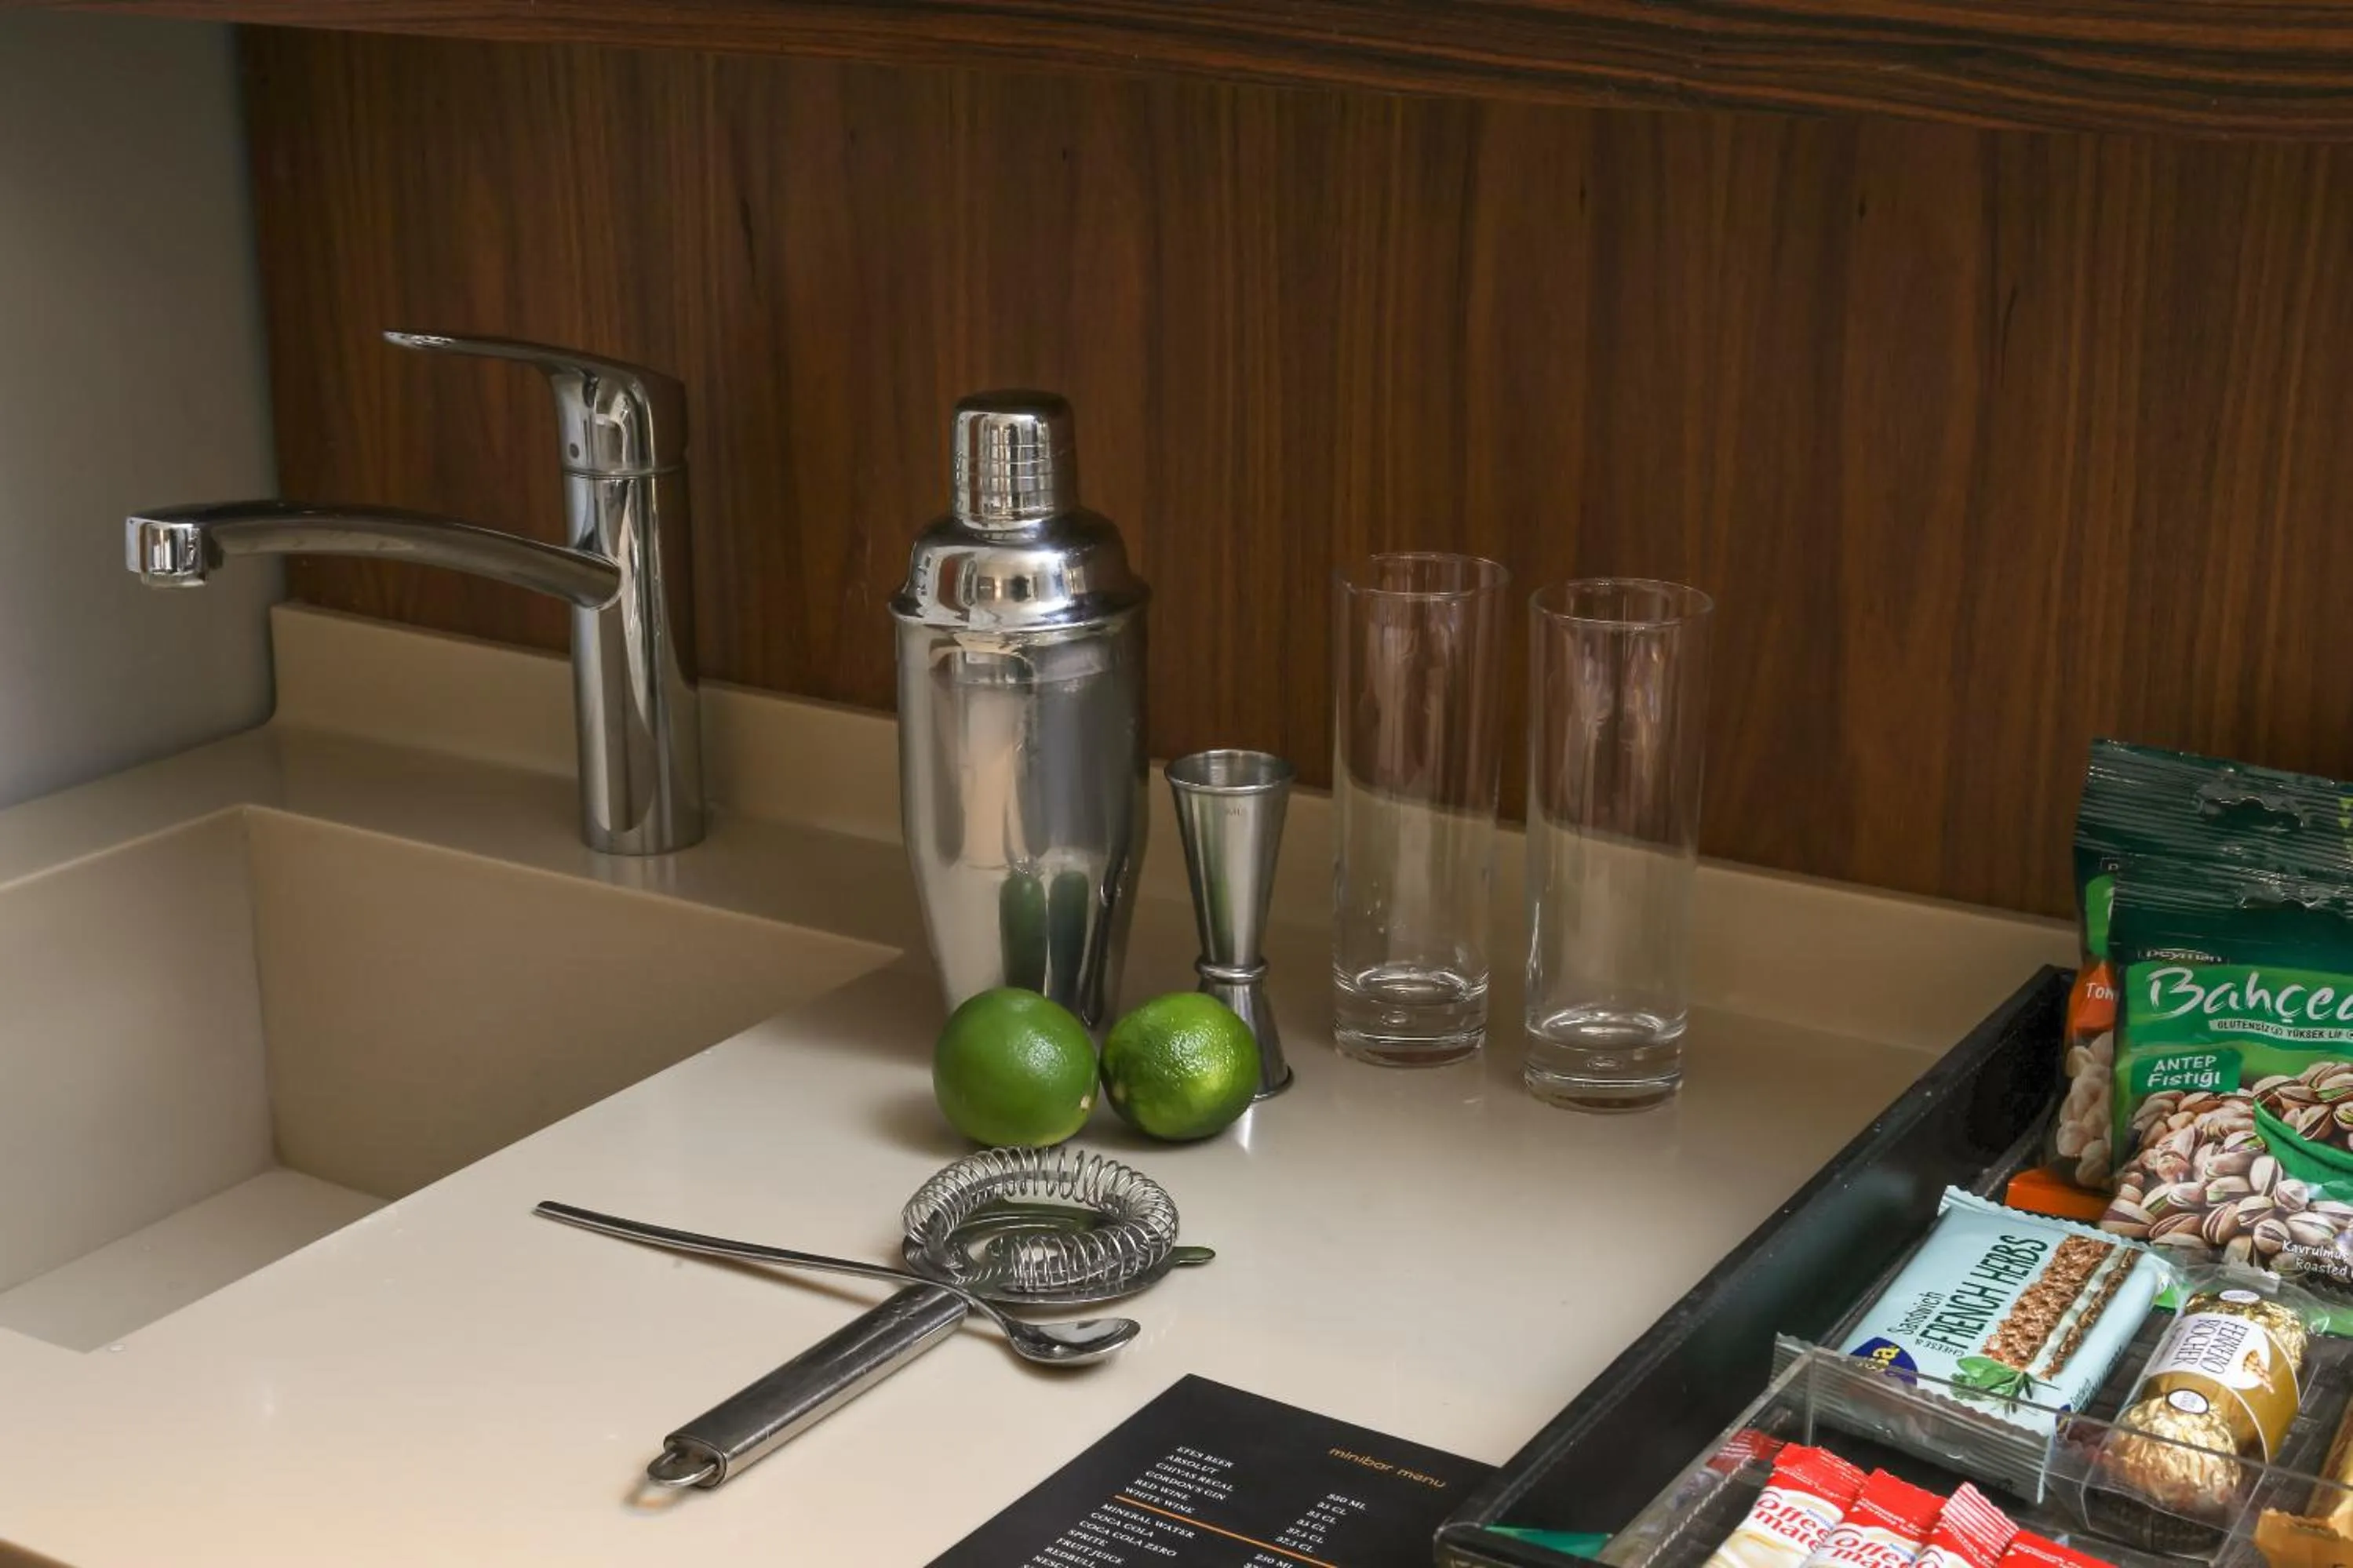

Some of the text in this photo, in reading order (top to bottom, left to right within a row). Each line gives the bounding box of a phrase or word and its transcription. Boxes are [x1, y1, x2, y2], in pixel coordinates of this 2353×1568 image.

[2153, 1055, 2217, 1073] ANTEP
[2296, 1257, 2348, 1275] Roasted
[1919, 1235, 2049, 1349] FRENCH HERBS
[1887, 1291, 1946, 1335] Sandwich
[2171, 1319, 2222, 1366] ROCHER
[2199, 1321, 2249, 1374] FERRERO
[1156, 1462, 1197, 1479] CHIVAS
[1166, 1455, 1220, 1475] ABSOLUT
[1329, 1448, 1446, 1488] minibar menu
[1125, 1487, 1195, 1514] WHITE WINE
[1134, 1479, 1191, 1501] RED WINE
[1101, 1503, 1196, 1539] MINERAL WATER
[1322, 1514, 1337, 1524] CL
[1331, 1506, 1347, 1516] CL
[1091, 1512, 1153, 1538] COCA COLA
[1311, 1523, 1327, 1533] CL
[1754, 1511, 1821, 1554] mate
[1068, 1530, 1108, 1547] SPRITE
[1079, 1520, 1177, 1557] COCA COLA ZERO
[1298, 1543, 1313, 1553] CL
[1309, 1534, 1324, 1544] CL
[1044, 1547, 1095, 1568] REDBULL
[1056, 1537, 1124, 1565] FRUIT JUICE
